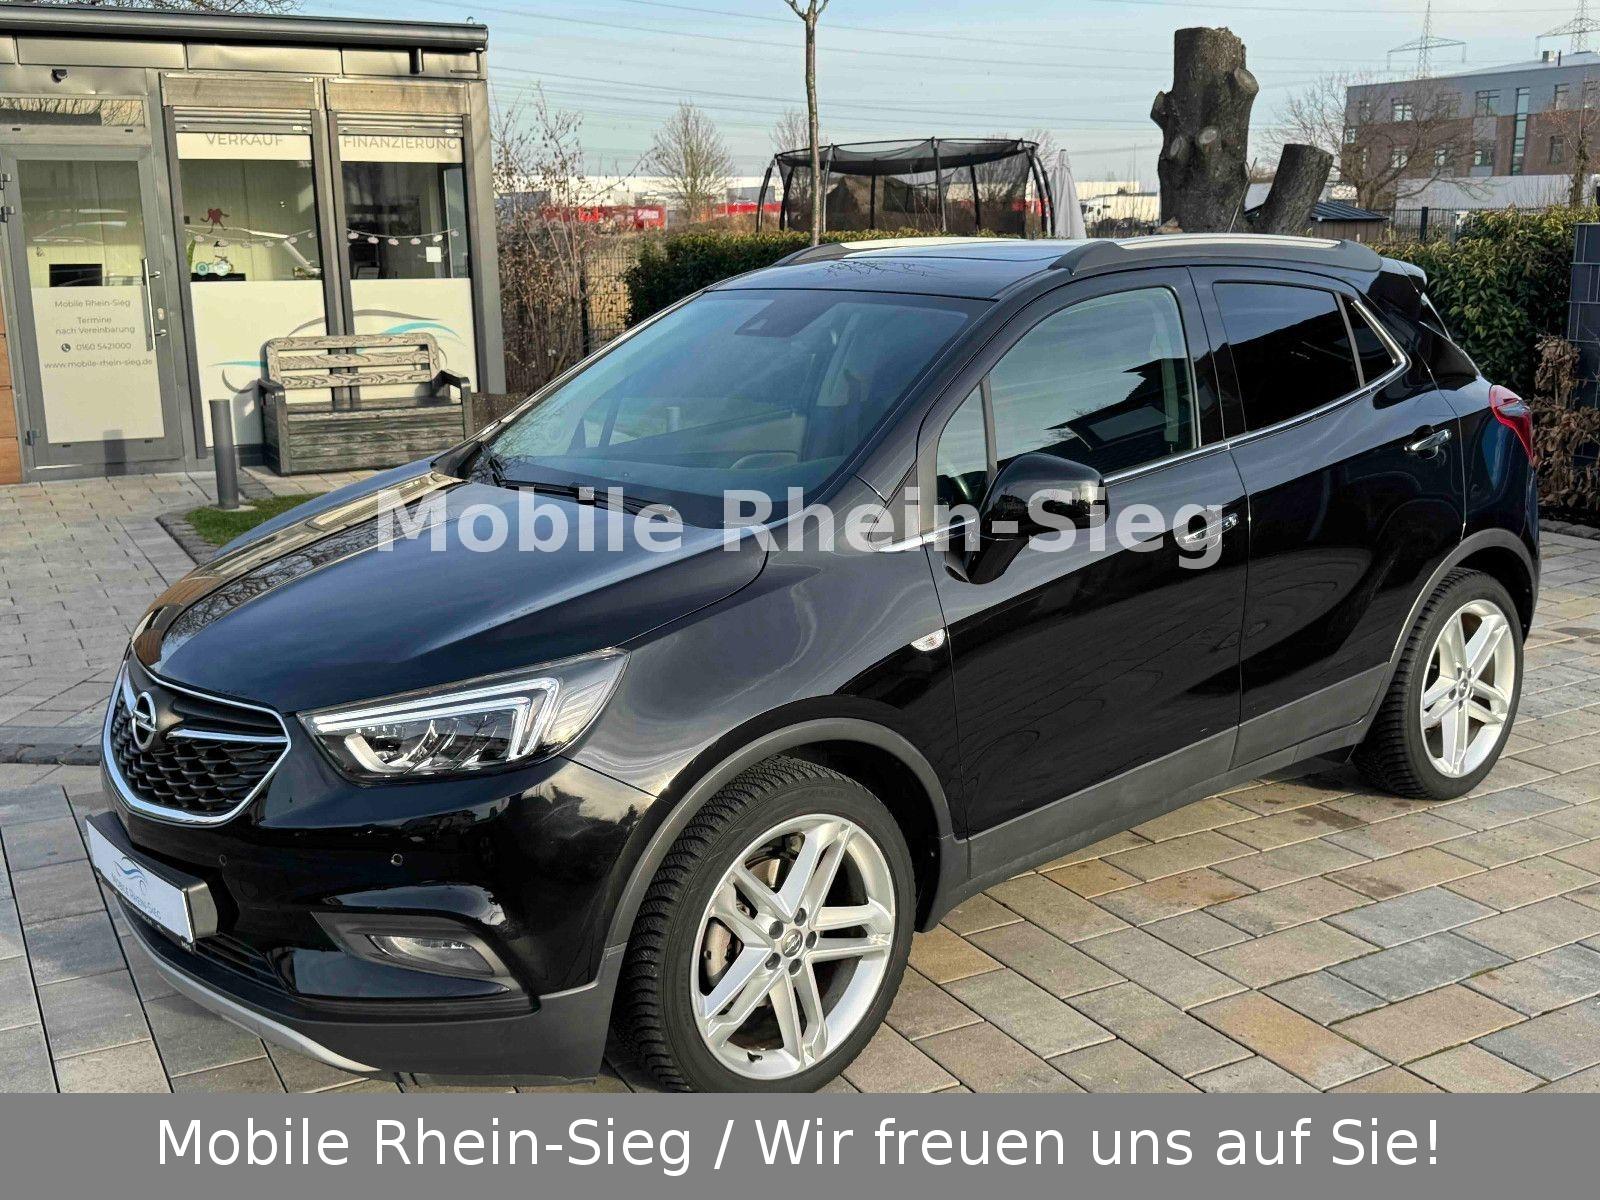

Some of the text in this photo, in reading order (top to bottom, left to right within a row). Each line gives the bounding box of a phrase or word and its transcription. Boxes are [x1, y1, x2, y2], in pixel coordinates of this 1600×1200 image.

[206, 134, 283, 146] VERKAUF
[343, 136, 457, 149] FINANZIERUNG
[54, 299, 131, 308] Mobile Rhein-Sieg
[77, 316, 112, 325] Termine
[55, 326, 135, 335] nach Vereinbarung
[44, 359, 153, 369] www.mobile-rhein-sieg.de
